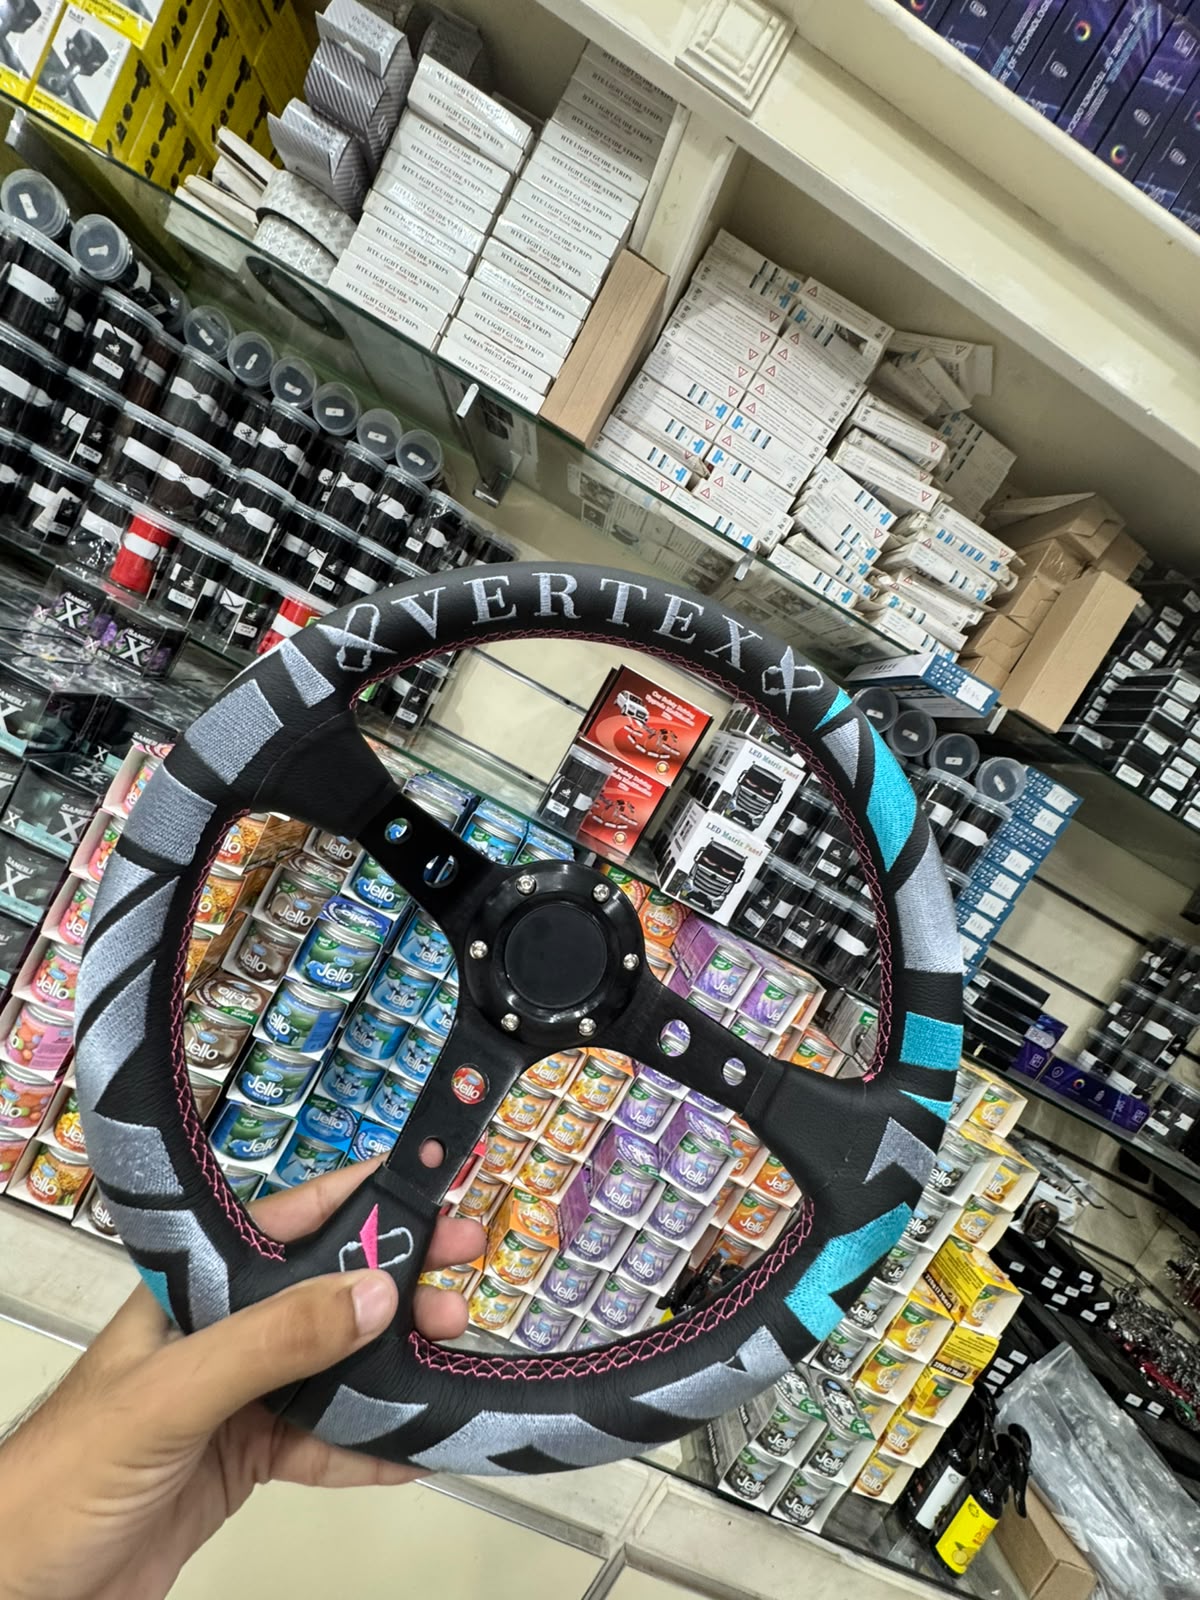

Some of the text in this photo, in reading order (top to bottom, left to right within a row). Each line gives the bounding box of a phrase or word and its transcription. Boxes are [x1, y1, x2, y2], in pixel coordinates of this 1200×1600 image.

[56, 599, 89, 629] X
[391, 572, 763, 673] VERTEX
[120, 635, 151, 666] X
[748, 747, 762, 759] LED
[763, 754, 781, 770] Matrix
[53, 811, 88, 844] X
[706, 822, 721, 834] LED
[722, 830, 744, 847] Matrix
[323, 839, 352, 859] Jello
[0, 863, 31, 898] X
[363, 879, 395, 902] Jello
[278, 905, 311, 926] Jello
[648, 909, 674, 926] Jello
[239, 951, 267, 973] Jello
[415, 948, 444, 964] Jello
[316, 965, 354, 984] Jello
[37, 974, 69, 999] Jello
[385, 990, 413, 1008] Jello
[403, 1052, 427, 1074] Jello
[533, 1066, 559, 1082] Jello
[247, 1075, 283, 1098] Jello
[332, 1080, 358, 1097] Jello
[453, 1080, 480, 1099] Jello
[584, 1089, 608, 1105] Jello
[380, 1099, 403, 1120] Jello
[509, 1108, 535, 1124] Jello
[630, 1110, 656, 1128] Jello
[312, 1112, 343, 1129] Jello
[243, 1137, 279, 1153] Jello
[550, 1127, 575, 1145] Jello
[30, 1171, 57, 1197] Jello
[530, 1175, 555, 1190] Jello
[679, 1164, 707, 1185] Jello
[766, 1176, 790, 1191] Jello
[930, 1168, 952, 1187] ello
[604, 1186, 633, 1209] Jello
[658, 1214, 685, 1233] Jello
[740, 1217, 764, 1233] Jello
[574, 1234, 602, 1255] Jello
[505, 1263, 532, 1278] Jello
[627, 1256, 655, 1278] Jello
[551, 1282, 579, 1302] Jello
[480, 1308, 507, 1323] Jello
[600, 1303, 627, 1324] Jello
[850, 1304, 878, 1322] Jello
[524, 1325, 551, 1345] Jello
[768, 1432, 795, 1451] Jello
[815, 1452, 844, 1470] Jello
[736, 1475, 765, 1494] Jello
[785, 1497, 814, 1518] Jello
